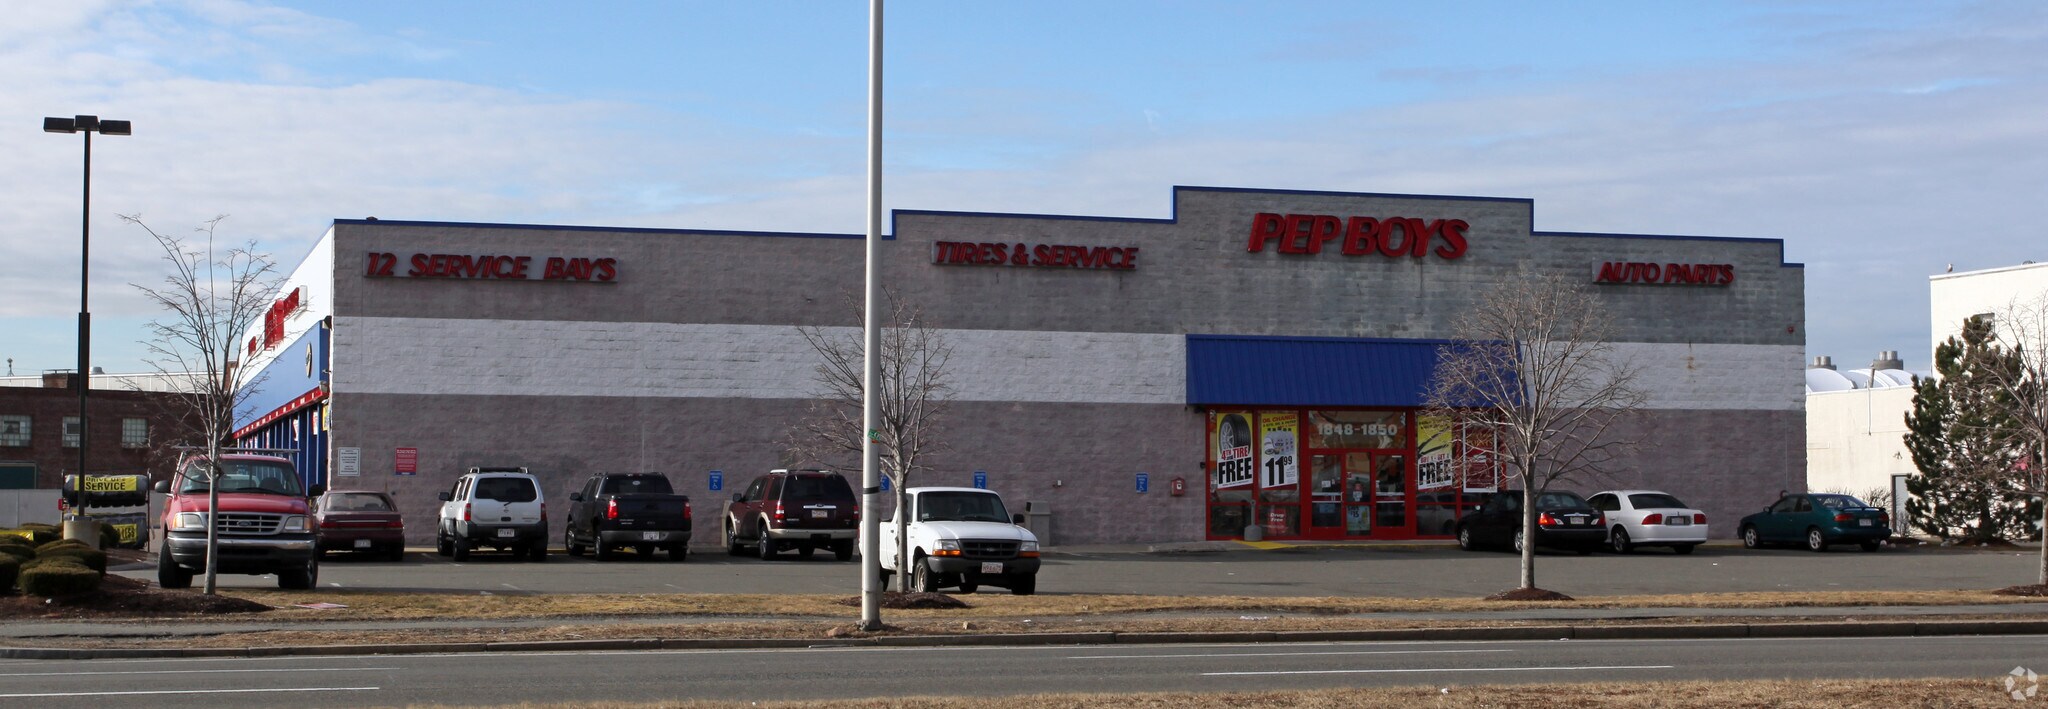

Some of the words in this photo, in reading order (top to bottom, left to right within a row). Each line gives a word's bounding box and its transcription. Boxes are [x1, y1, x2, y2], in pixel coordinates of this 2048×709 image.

[1247, 212, 1342, 254] PEP
[1341, 216, 1470, 259] BOYS
[368, 252, 397, 276] 12
[408, 253, 531, 279] SERVICE
[544, 256, 617, 281] BAYS
[936, 241, 1008, 265] TIRES
[1011, 242, 1029, 266] &
[1032, 244, 1139, 269] SERVICE
[1597, 262, 1661, 283] AUTO
[1663, 263, 1735, 285] PARTS
[1317, 423, 1398, 436] 1848-1850
[1233, 447, 1248, 459] TIRE
[1218, 457, 1252, 484] FREE
[1419, 459, 1452, 485] FREE
[85, 482, 126, 491] SERVICE
